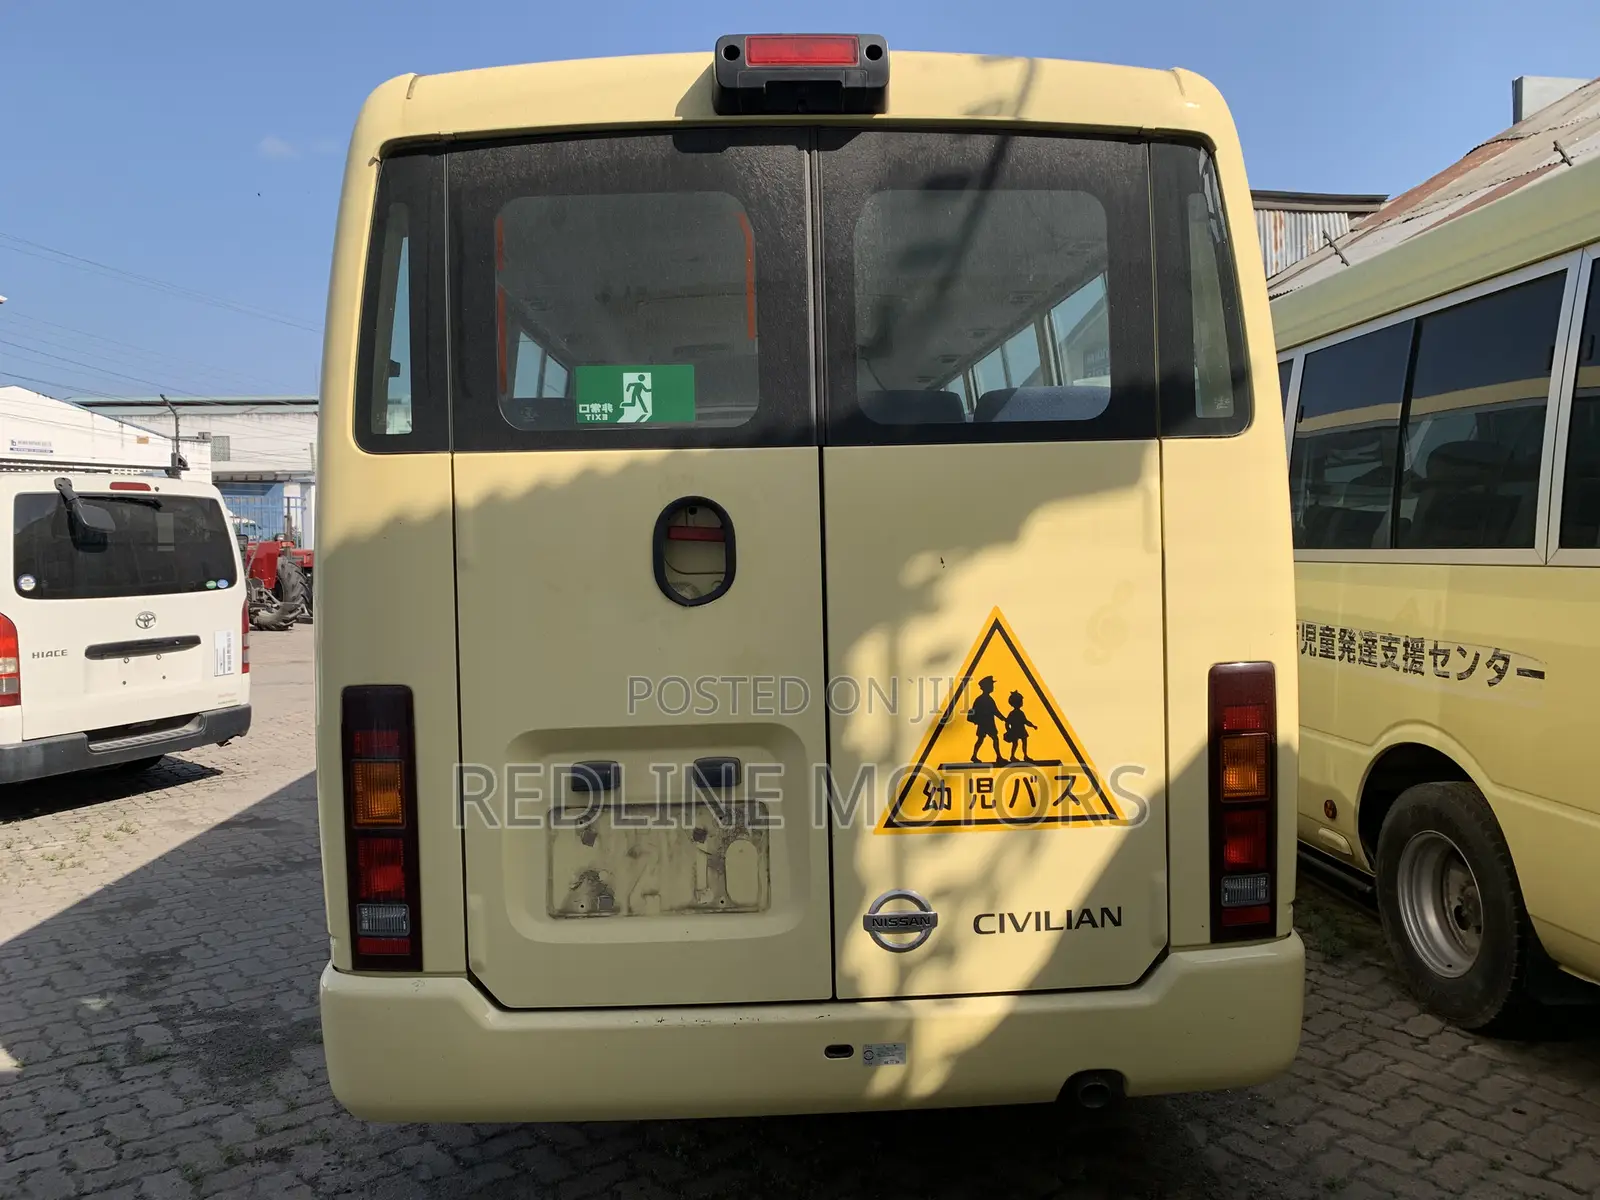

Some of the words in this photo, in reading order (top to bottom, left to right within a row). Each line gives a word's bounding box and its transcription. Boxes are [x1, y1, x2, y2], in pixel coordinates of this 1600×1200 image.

[32, 649, 68, 659] HIACE
[1297, 622, 1546, 687] 児童発達支援センター
[921, 774, 1082, 812] 幼児バス
[872, 916, 931, 927] NISSAN
[973, 906, 1122, 935] CIVILIAN
